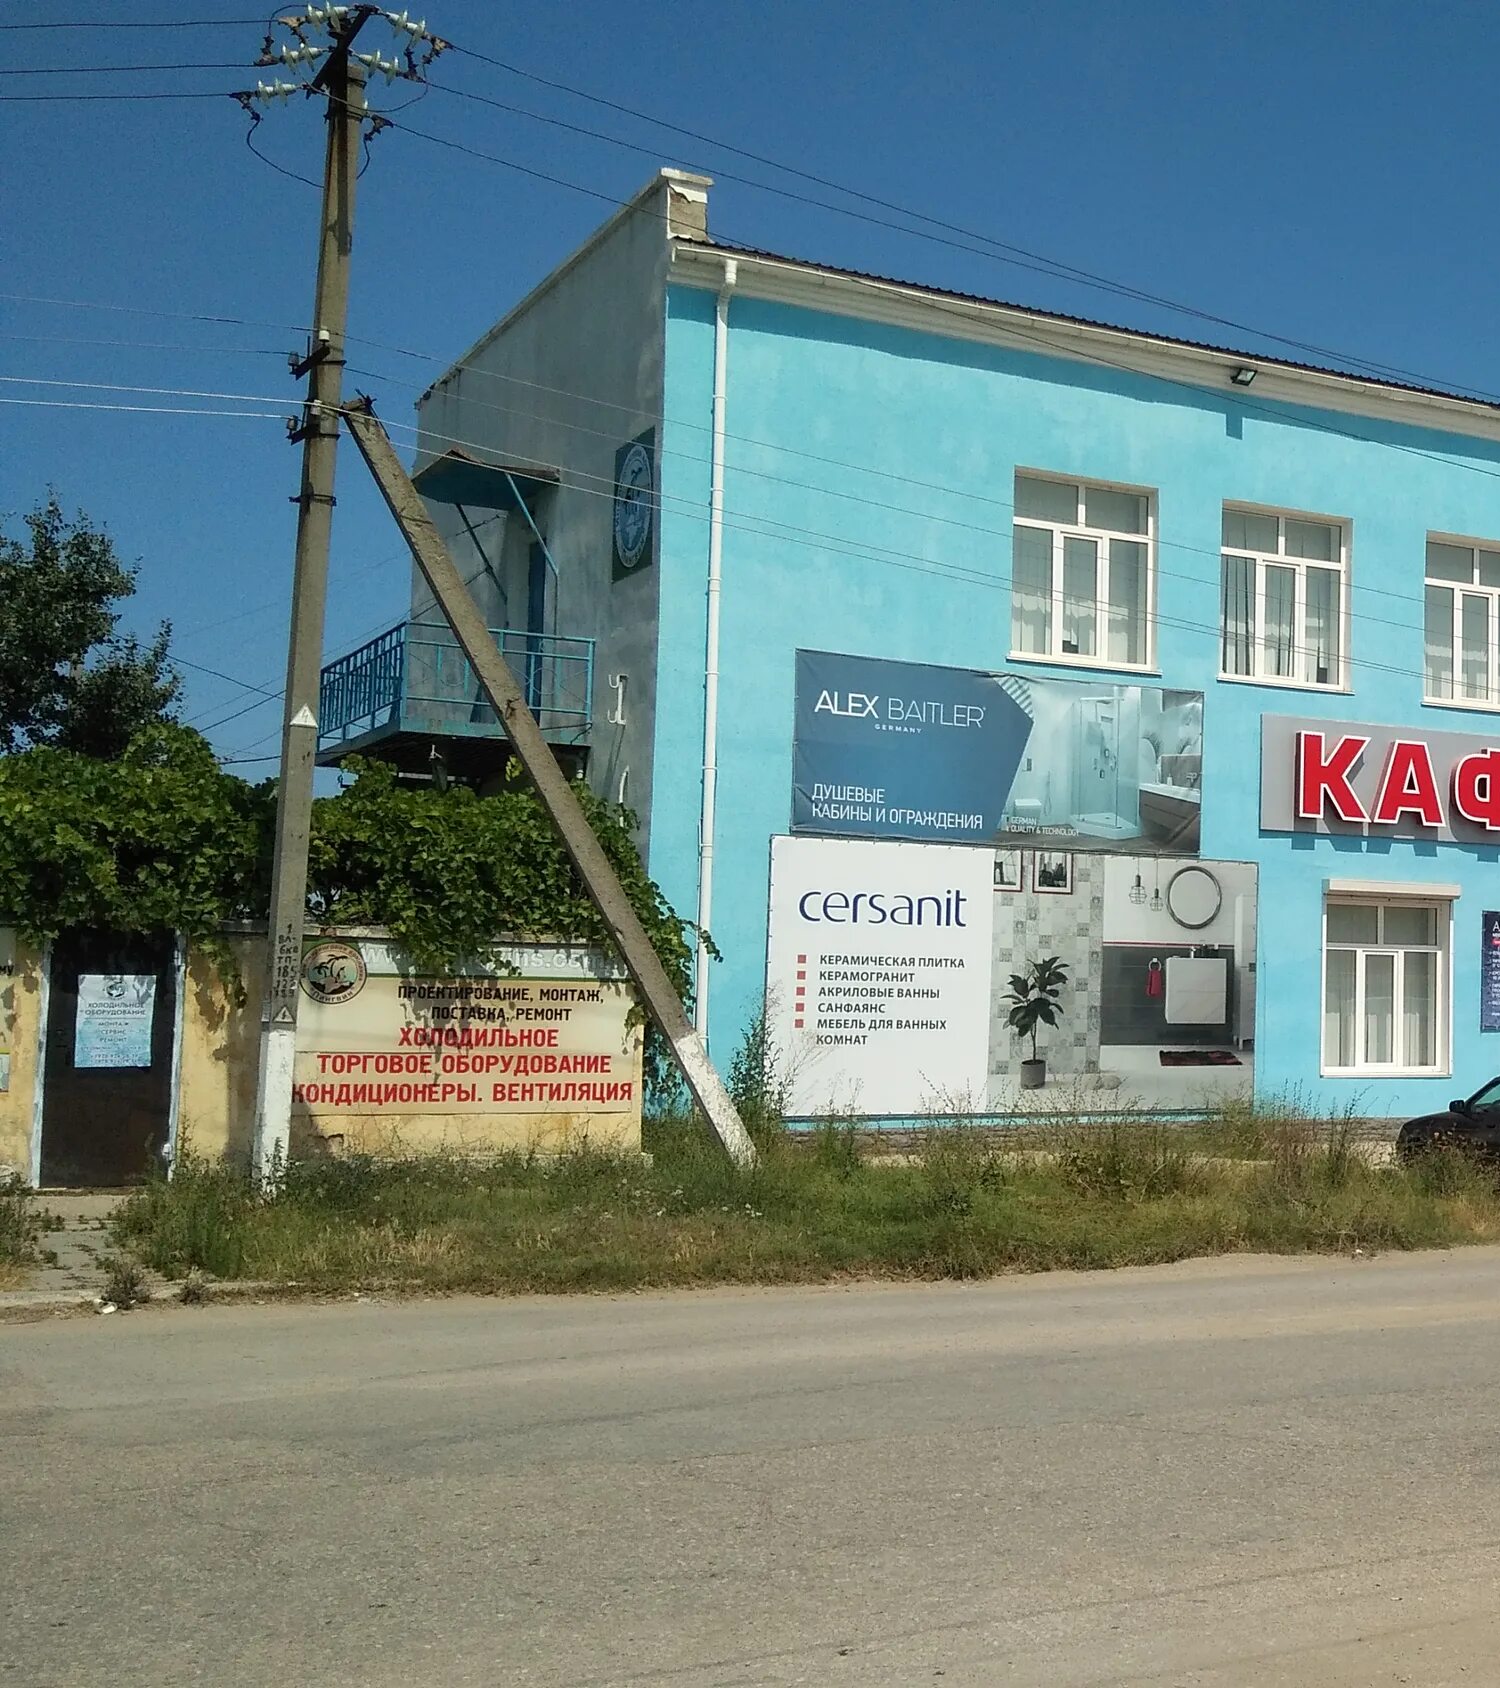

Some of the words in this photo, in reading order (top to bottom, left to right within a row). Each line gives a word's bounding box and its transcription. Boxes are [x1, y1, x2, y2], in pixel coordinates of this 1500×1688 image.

[814, 689, 879, 719] ALEX
[888, 697, 985, 728] BAITLER
[874, 723, 923, 734] GERMANY
[811, 783, 886, 804] ДУШЕВЫЕ
[811, 803, 872, 822] КАБИНЫ
[875, 807, 886, 823] И
[889, 808, 984, 830] ОГРАЖДЕНИЯ
[1011, 816, 1037, 825] GERMAN
[1010, 825, 1036, 834] QUALITY
[798, 888, 967, 928] cersanit
[819, 954, 916, 967] КЕРАМИЧЕСКАЯ
[918, 957, 965, 969] ПЛИТКА
[819, 970, 915, 983] КЕРАМОГРАНИТ
[397, 985, 534, 1003] ПРОЕКТИРОВАНИЕ,
[539, 988, 604, 1004] МОНТАЖ,
[818, 986, 894, 998] АКРИЛОВЫЕ
[897, 988, 940, 999] ВАННЫ
[431, 1006, 510, 1022] ПОСТАВКА,
[515, 1008, 573, 1021] РЕМОНТ
[817, 1002, 886, 1014] САНФАЯНС
[816, 1018, 866, 1029] МЕБЕЛЬ
[868, 1019, 893, 1031] ДЛЯ
[896, 1019, 947, 1030] ВАННЫХ
[398, 1028, 559, 1050] ХОЛОДИЛЬНОЕ
[816, 1034, 868, 1045] КОМНАТ
[317, 1054, 432, 1074] ТОРГОВОЕ
[441, 1054, 612, 1076] ОБОРУДОВАНИЕ
[292, 1083, 483, 1106] КОНДИЦИОНЕРЫ.
[493, 1082, 632, 1105] ВЕНТИЛЯЦИЯ
